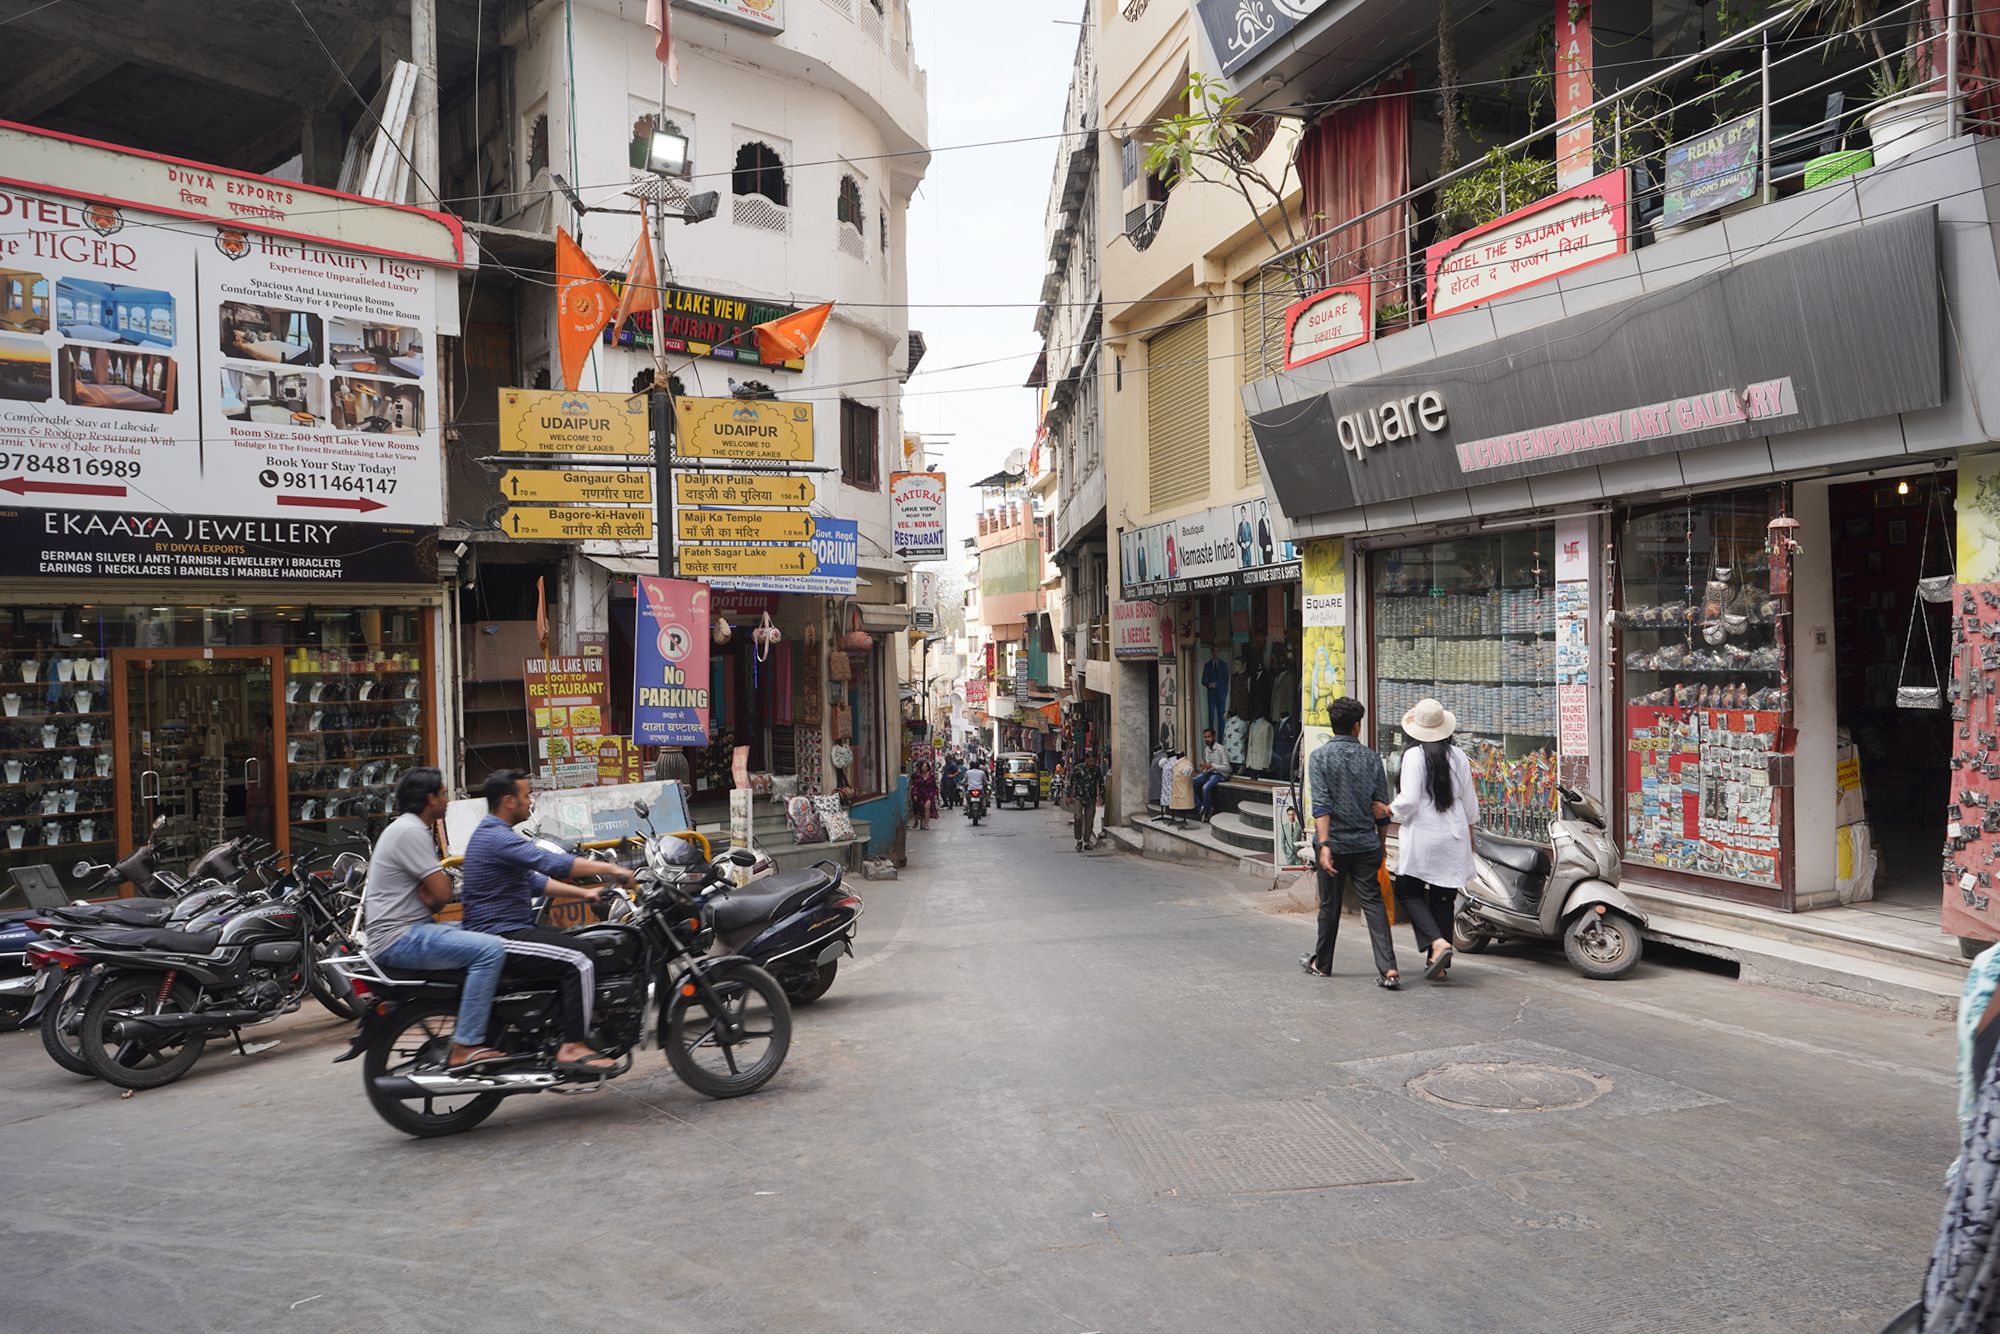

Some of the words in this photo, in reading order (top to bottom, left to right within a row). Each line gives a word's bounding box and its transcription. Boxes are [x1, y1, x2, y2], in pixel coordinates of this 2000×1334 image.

[1688, 133, 1725, 161] RELAX
[1728, 125, 1743, 145] BY
[169, 169, 214, 190] DIVYA
[227, 182, 293, 204] EXPORTS
[1690, 181, 1719, 199] ROOMS
[28, 229, 138, 271] TIGER
[1442, 254, 1480, 277] HOTEL
[1484, 241, 1508, 260] THE
[1515, 219, 1566, 250] SAJJAN
[1571, 204, 1611, 229] VILLA
[254, 234, 294, 259] The
[300, 242, 371, 274] Luxury
[377, 257, 425, 282] Tiger
[1450, 272, 1480, 296] होटल
[1509, 249, 1549, 274] सज्जन
[1559, 234, 1590, 257] विला
[270, 262, 324, 279] Experience
[326, 272, 386, 288] Unparalleled
[388, 281, 419, 294] Luxury
[220, 283, 282, 301] Comfortable
[284, 293, 303, 304] Stay
[306, 296, 323, 306] For
[332, 300, 363, 314] People
[376, 307, 394, 317] One
[395, 310, 421, 321] Room
[250, 278, 294, 293] Spacious
[295, 285, 315, 296] And
[317, 288, 363, 303] Luxurious
[365, 296, 395, 308] Rooms
[675, 291, 709, 315] LAKE
[713, 298, 747, 321] VIEW
[1309, 302, 1348, 328] SQUARE
[636, 310, 725, 340] RETAURANT
[4, 411, 72, 426] Comfortable
[76, 418, 97, 430] Stay
[114, 421, 159, 434] Lakeside
[541, 416, 611, 430] UDAIPUR
[714, 424, 778, 438] UDAIPUR
[1337, 390, 1448, 461] quare
[44, 427, 86, 441] Rooftop
[90, 431, 146, 444] Restaurant
[150, 435, 175, 446] With
[230, 427, 262, 438] Room
[264, 430, 289, 440] Size:
[313, 434, 334, 445] Sqft
[335, 435, 359, 446] Lake
[361, 438, 385, 448] View
[387, 440, 420, 451] Rooms
[1461, 445, 1474, 470] A
[1475, 414, 1624, 467] CONTEMPORARY
[1629, 404, 1671, 440] ART
[29, 438, 58, 449] View
[61, 441, 71, 452] of
[74, 441, 100, 453] Lake
[104, 444, 140, 455] Pichola
[234, 440, 267, 450] Indulge
[323, 446, 374, 459] Breathtaking
[0, 452, 141, 478] 9784816989
[266, 456, 298, 468] Book
[300, 458, 329, 471] Your
[331, 461, 356, 473] Stay
[358, 463, 396, 476] Today!
[283, 472, 398, 494] 9811464147
[563, 473, 613, 485] Gangaur
[617, 473, 644, 484] Ghat
[684, 474, 709, 486] Daiji
[727, 475, 754, 485] Pulia
[581, 487, 619, 499] गणगौर
[623, 488, 644, 499] घाट
[685, 487, 718, 500] दाइजी
[722, 487, 736, 500] की
[740, 488, 772, 504] पुलिया
[895, 489, 942, 505] NATURAL
[549, 509, 645, 521] Bagore-ki-Haveli
[685, 513, 706, 523] Maji
[726, 513, 762, 523] Temple
[45, 512, 174, 538] EKAAYA
[185, 519, 338, 544] JEWELLERY
[561, 522, 593, 536] बागौर
[596, 523, 612, 535] की
[616, 523, 644, 536] हवेली
[701, 524, 714, 537] जी
[735, 525, 760, 537] मंदिर
[894, 529, 944, 545] RESTAURANT
[1182, 524, 1204, 537] Boutique
[202, 544, 245, 554] EXPORTS
[714, 549, 742, 559] Sagar
[796, 539, 856, 566] PORIUM
[1179, 544, 1213, 568] Namaste
[1214, 537, 1236, 560] India
[41, 551, 93, 562] GERMAN
[96, 552, 136, 563] SILVER
[145, 554, 221, 565] ANTI-TARNISH
[224, 556, 284, 567] JEWELLERY
[292, 558, 341, 568] BRACLETS
[685, 562, 709, 572] फतेह
[713, 562, 737, 572] सागर
[39, 562, 92, 574] EARINGS
[105, 564, 171, 575] NECKLACES
[180, 566, 229, 577] BANGLES
[237, 567, 279, 577] MARBLE
[281, 568, 343, 579] HANDICRAFT
[1193, 578, 1213, 589] TAILOR
[1214, 576, 1230, 587] SHOP
[1259, 570, 1269, 582] MADE
[1114, 604, 1135, 620] INDIAN
[1135, 600, 1157, 619] BRUSH
[1306, 598, 1342, 610] SQUARE
[1128, 627, 1151, 643] NEEDLE
[563, 659, 581, 672] LAKE
[583, 658, 602, 672] VIEW
[664, 665, 685, 685] No
[639, 688, 708, 708] PARKING
[1562, 705, 1585, 713] MAGNET
[642, 722, 665, 732] थाना
